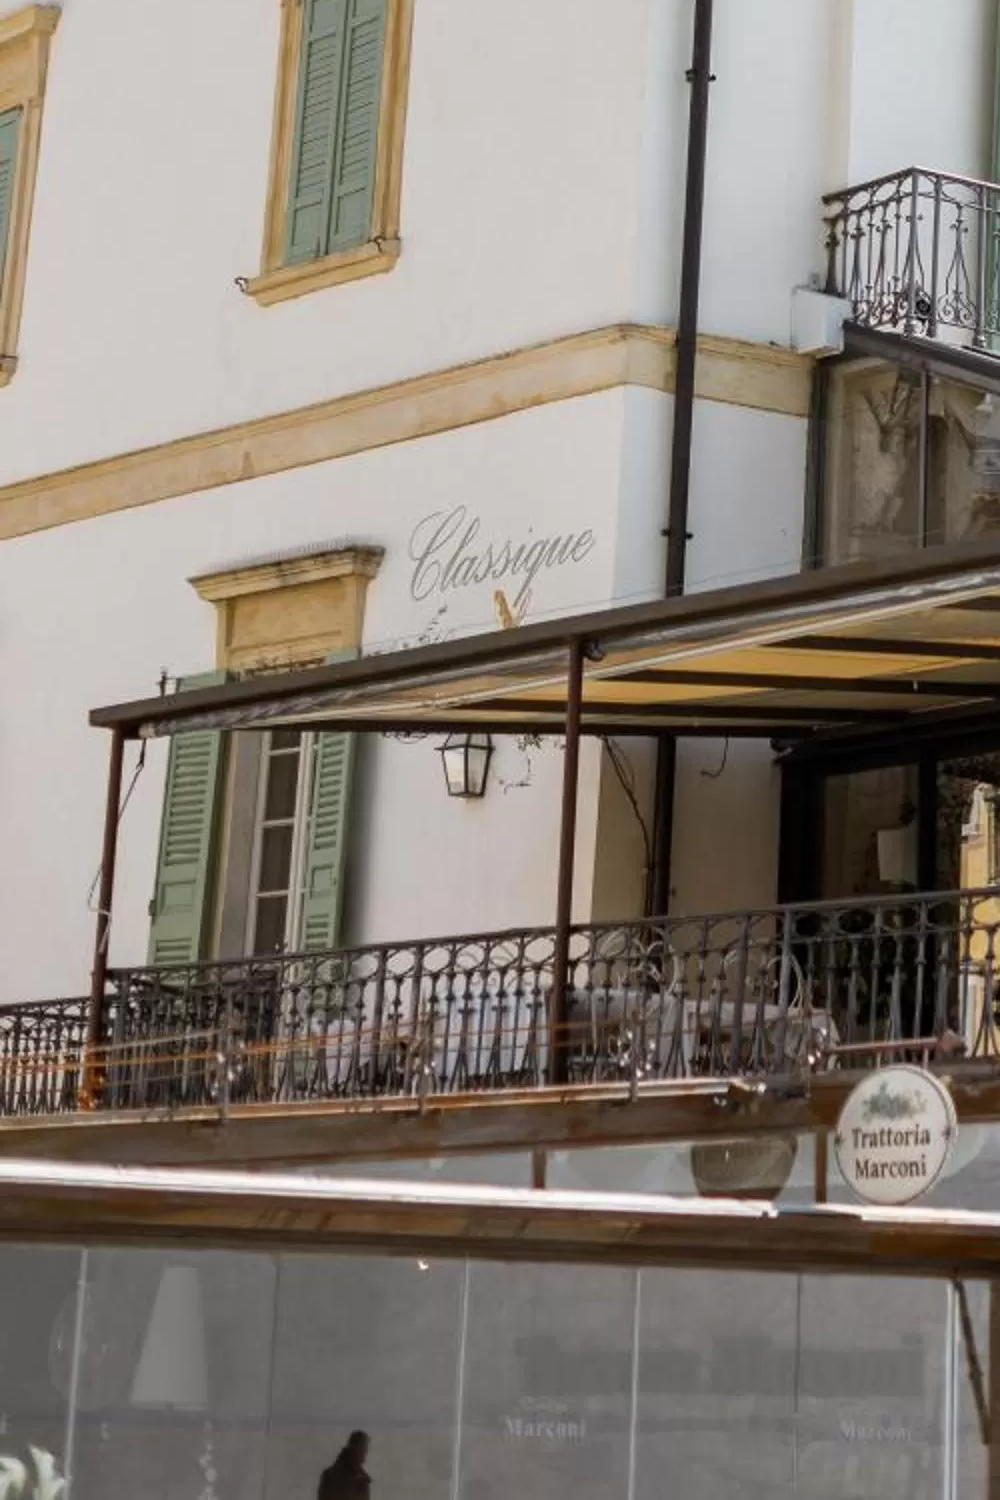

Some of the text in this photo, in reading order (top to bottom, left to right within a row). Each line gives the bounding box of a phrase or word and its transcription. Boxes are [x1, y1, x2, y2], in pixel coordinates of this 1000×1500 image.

[410, 504, 595, 621] Classique
[852, 1124, 931, 1149] Trattoria
[855, 1154, 927, 1181] Marconi
